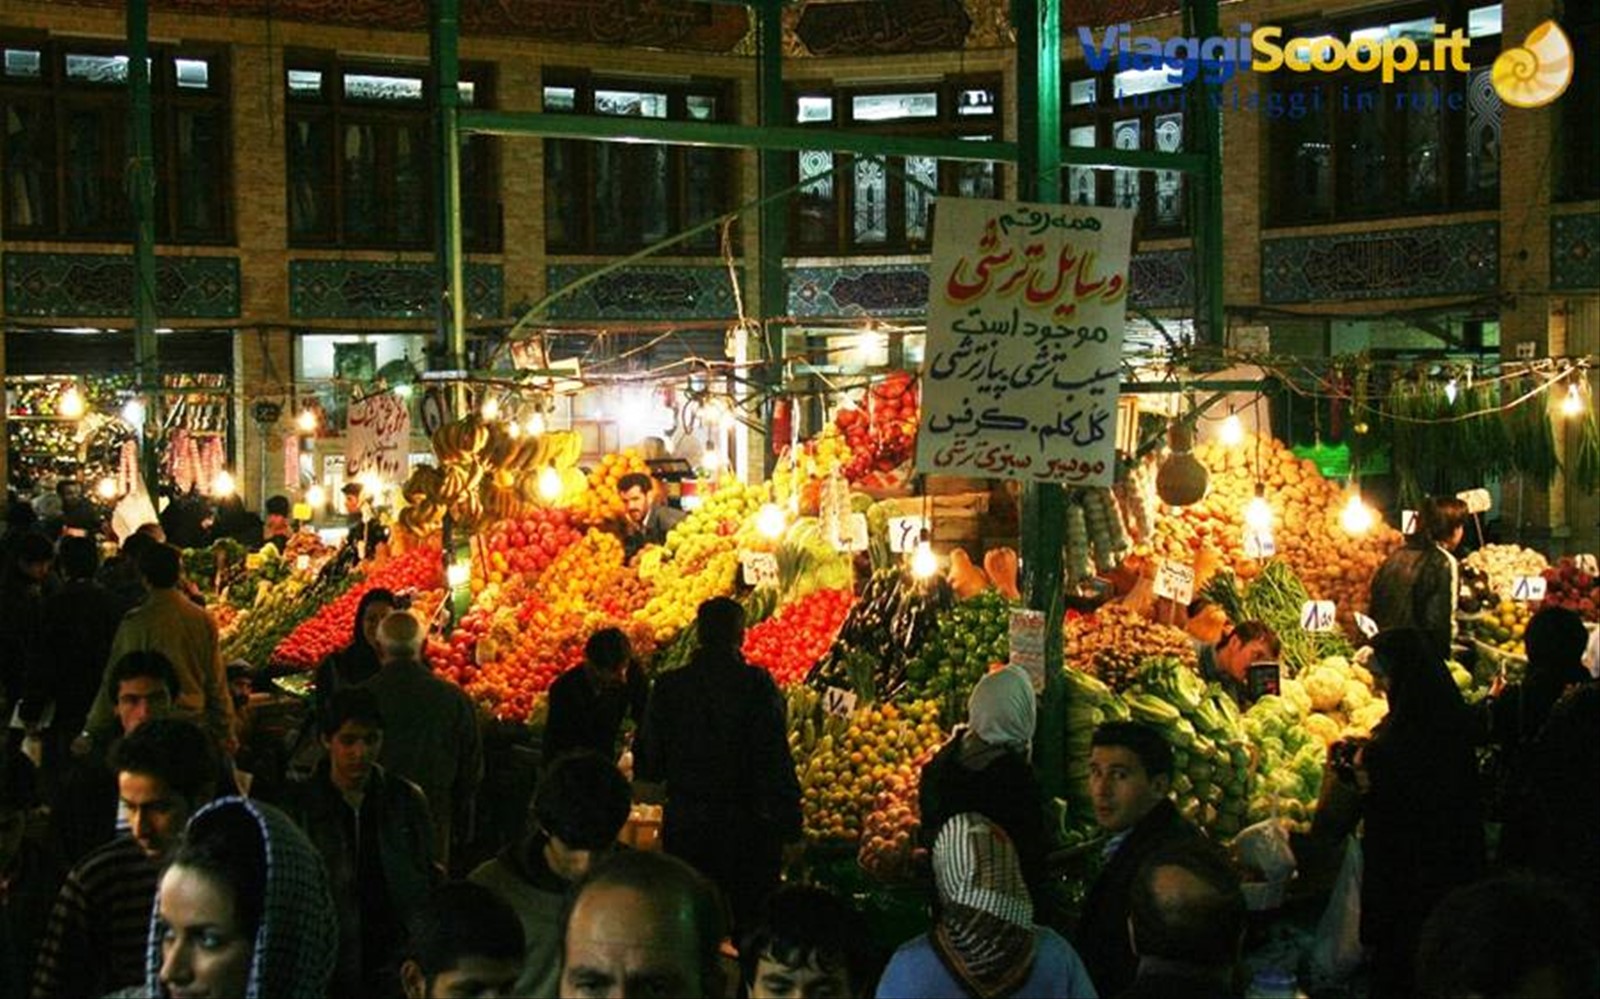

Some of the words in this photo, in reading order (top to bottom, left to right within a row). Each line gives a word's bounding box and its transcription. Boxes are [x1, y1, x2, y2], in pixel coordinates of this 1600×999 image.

[999, 207, 1049, 235] رقم
[1052, 212, 1102, 232] همه
[945, 217, 1045, 303] ترشی
[1023, 243, 1125, 316] وسایل
[952, 308, 1019, 336] است
[1022, 320, 1108, 348] موجود
[929, 336, 988, 381] ترشی
[1008, 344, 1067, 390] ترشی
[1052, 367, 1121, 402] سیب
[928, 397, 1029, 438] کرفس
[1072, 402, 1110, 447] گل
[1034, 456, 1106, 481] موسیر
